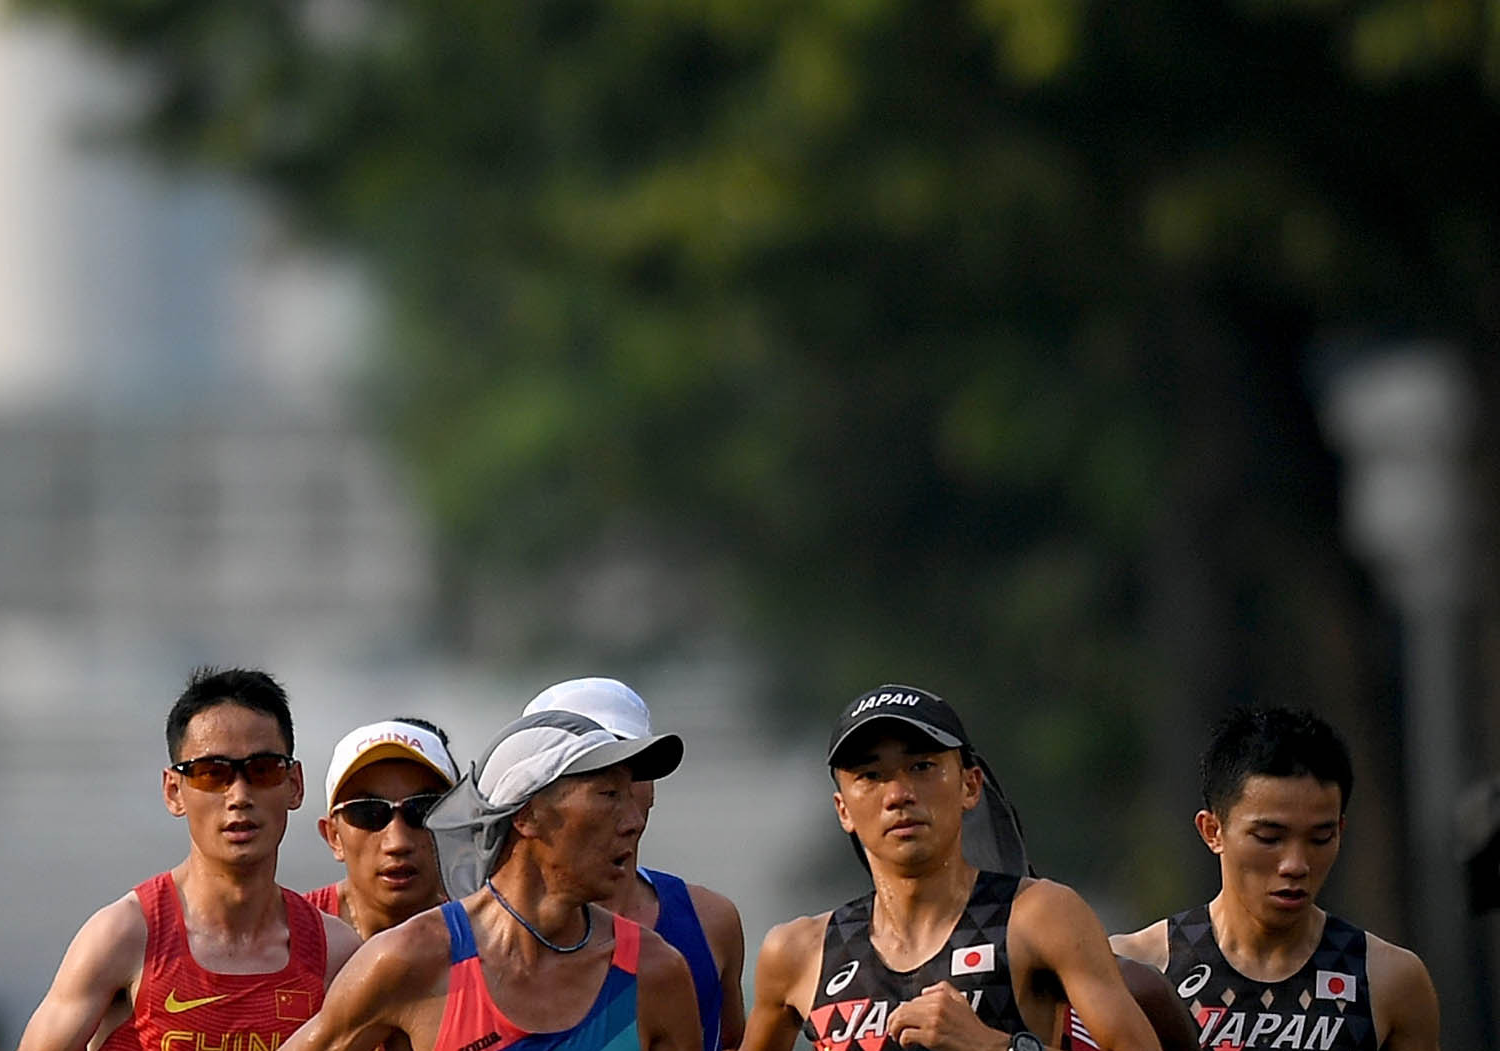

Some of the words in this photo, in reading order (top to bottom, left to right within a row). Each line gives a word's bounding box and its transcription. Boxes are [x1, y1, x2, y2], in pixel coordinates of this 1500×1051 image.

[850, 693, 921, 718] JAPAN
[356, 732, 425, 753] CHINA
[1198, 1011, 1345, 1051] JAPAN
